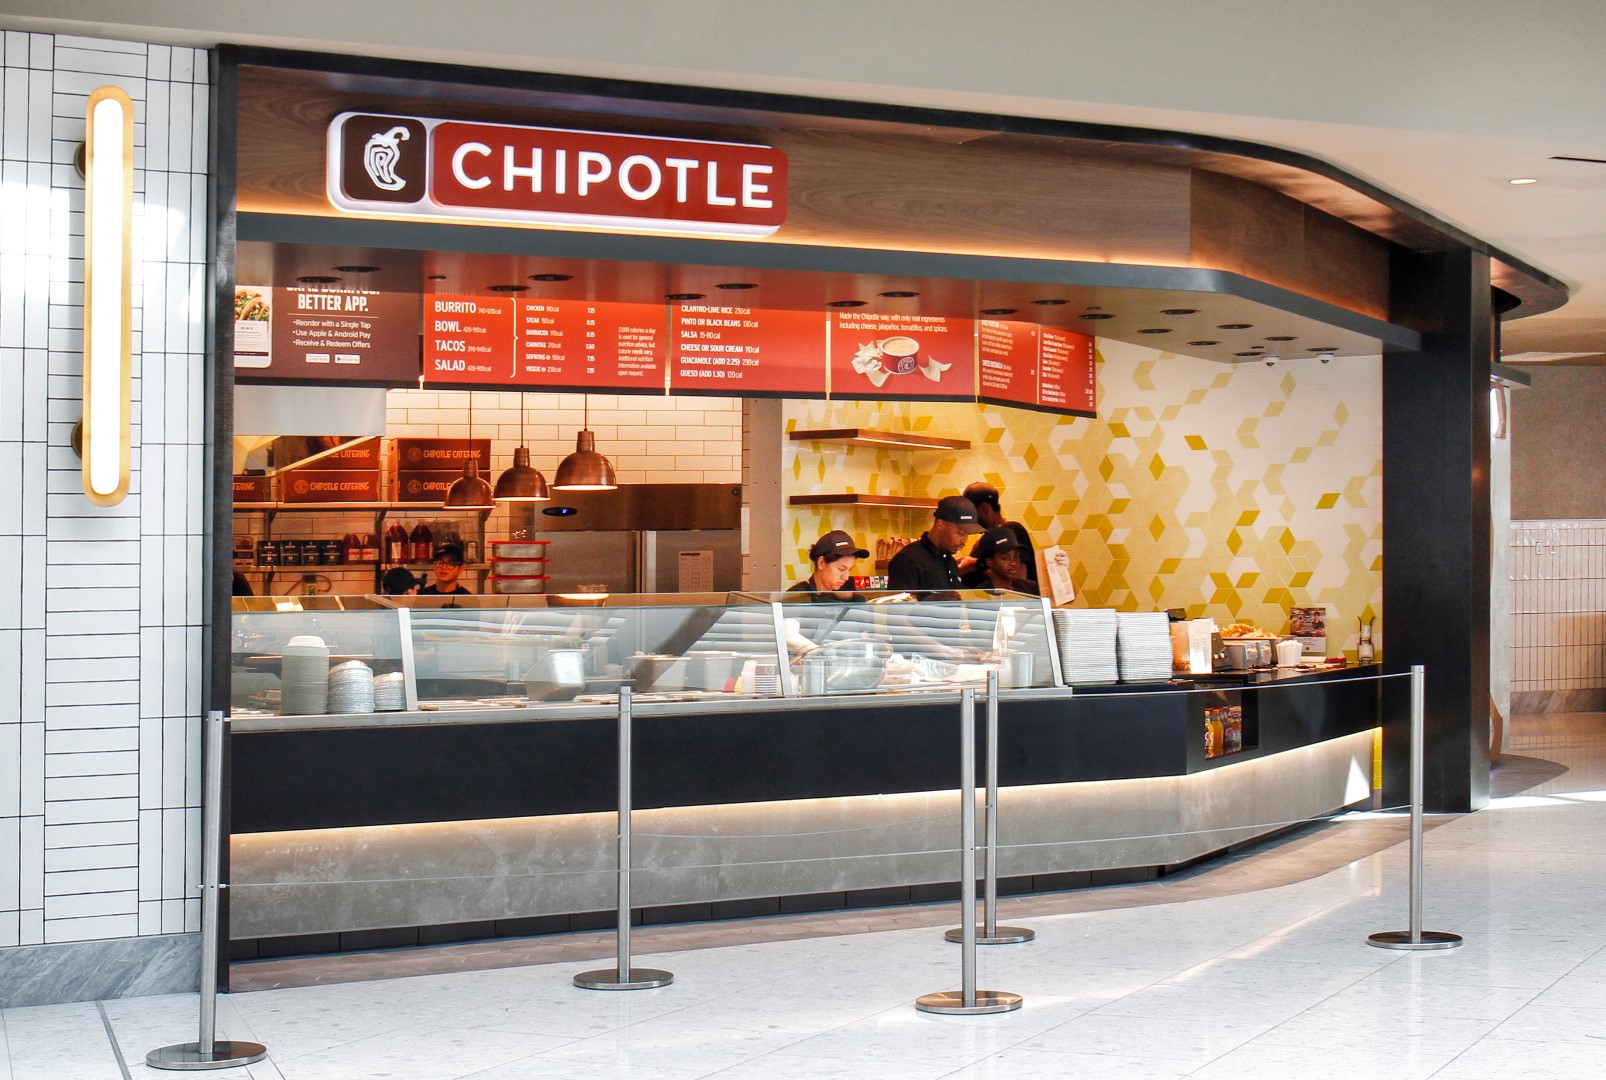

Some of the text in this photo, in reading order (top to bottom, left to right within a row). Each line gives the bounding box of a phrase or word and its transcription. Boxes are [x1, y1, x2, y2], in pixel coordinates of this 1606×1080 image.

[451, 141, 774, 209] CHIPOTLE
[297, 293, 369, 312] BETTER APP.
[434, 300, 477, 314] BURRITO
[525, 304, 545, 312] CHICKEN
[680, 305, 720, 313] CILANTRO-LIME
[721, 306, 733, 314] RICE
[839, 312, 852, 320] Made
[853, 312, 861, 320] the
[861, 313, 880, 321] Chipotle
[295, 319, 320, 327] Reorder
[321, 319, 335, 327] with
[340, 320, 359, 329] Single
[360, 321, 371, 329] Tap
[434, 320, 462, 333] BOWL
[680, 317, 697, 325] PINTO
[697, 318, 706, 326] OR
[706, 318, 723, 326] BLACK
[723, 319, 741, 327] BEANS
[839, 322, 860, 330] including
[308, 330, 327, 338] Apple
[359, 331, 371, 340] Pay
[680, 330, 698, 338] SALSA
[352, 340, 371, 348] Offers
[434, 339, 466, 352] TACOS
[680, 343, 701, 351] CHEESE
[701, 344, 710, 352] OR
[710, 344, 725, 352] SOUR
[724, 345, 744, 353] CREAM
[434, 359, 466, 371] SALAD
[680, 356, 712, 364] GUACAMOLE
[712, 357, 726, 365] (ADD
[726, 358, 741, 366] 2.25)
[680, 369, 699, 377] QUESO
[699, 370, 712, 378] (ADD
[340, 449, 370, 458] CATERING
[423, 450, 452, 458] CHIPOTLE
[233, 482, 255, 491] TERING
[310, 481, 370, 491] CHIPOTLE CATERING
[422, 482, 452, 491] CHIPOTLE
